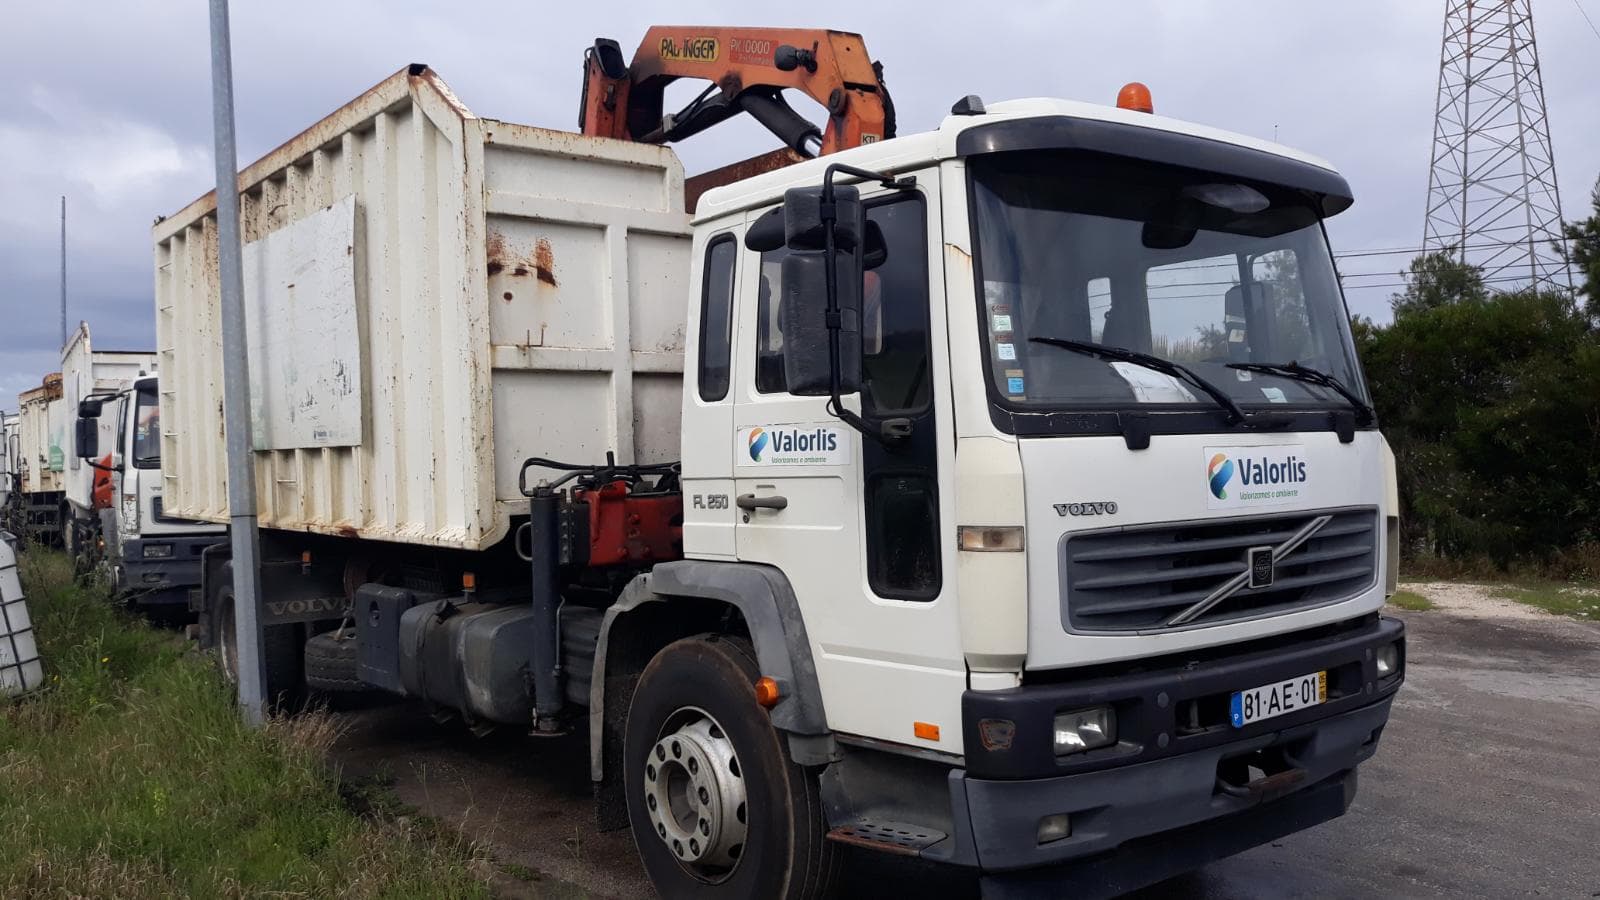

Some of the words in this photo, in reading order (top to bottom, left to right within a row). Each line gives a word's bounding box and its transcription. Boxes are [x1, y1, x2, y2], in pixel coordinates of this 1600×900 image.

[771, 429, 837, 453] Valorlis
[1238, 456, 1306, 486] Valorlis
[693, 494, 706, 509] FL
[707, 494, 729, 509] 250
[1053, 501, 1118, 516] VOLVO
[1234, 713, 1240, 721] P
